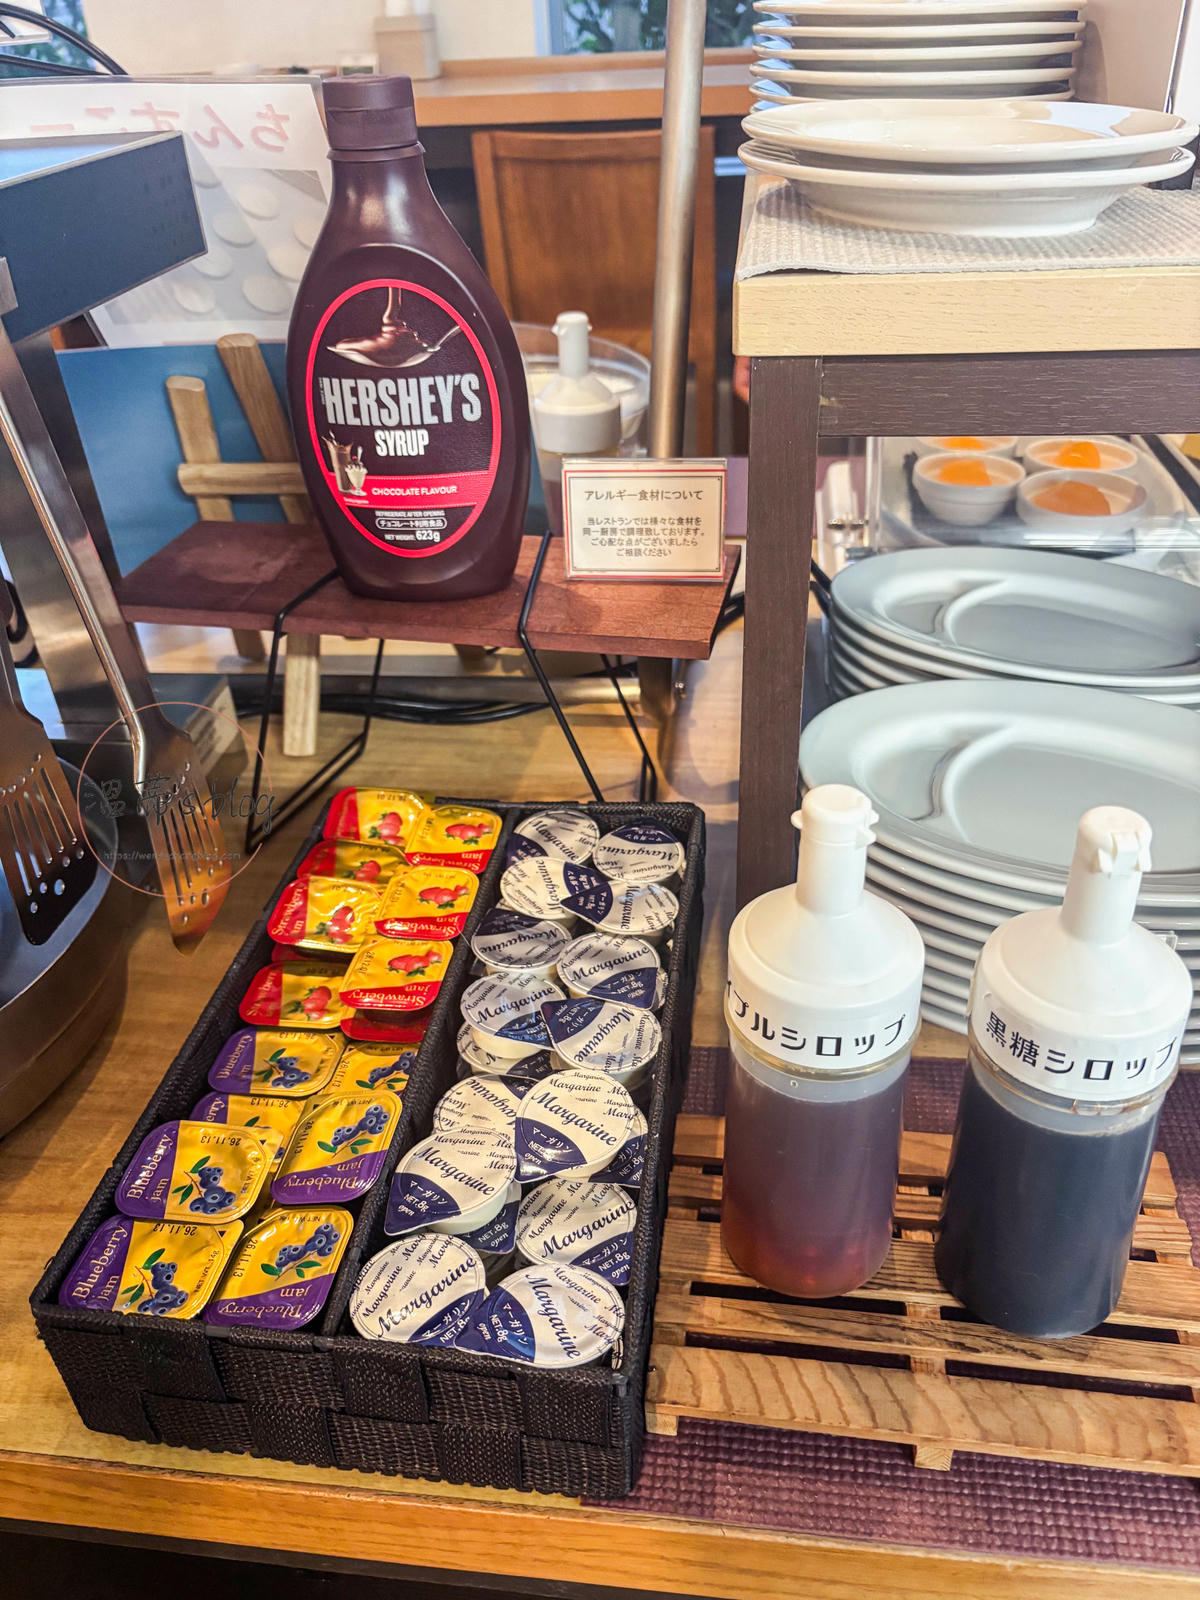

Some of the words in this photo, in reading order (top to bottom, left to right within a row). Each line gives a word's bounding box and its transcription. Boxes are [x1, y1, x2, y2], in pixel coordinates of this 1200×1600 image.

[322, 373, 482, 428] HERSHEY'S
[374, 429, 430, 457] SYRUP
[372, 487, 420, 496] CHOCOLATE
[421, 486, 458, 495] FLAVOUR
[584, 489, 704, 501] アレルギー食材について
[587, 517, 702, 526] 当レストランでは様々な食材を
[416, 530, 441, 543] 623g
[591, 537, 698, 547] ご心配な点がございましたら
[616, 547, 672, 557] ご相談ください
[532, 820, 579, 861] Margarine
[462, 852, 484, 863] jam
[599, 846, 679, 861] Margarine
[536, 860, 560, 910] Margarine
[621, 885, 641, 930] Margarine
[480, 928, 559, 953] Margarine
[561, 943, 593, 969] Margarine
[571, 946, 650, 982] Margarine
[348, 989, 426, 1006] Strawberry
[405, 984, 431, 996] jam
[465, 983, 497, 1010] Margarine
[477, 987, 555, 1023] Margarine
[574, 1008, 635, 1062] Margarine
[985, 1011, 1178, 1081] 黒糖シロップ
[550, 1078, 601, 1092] Margarine
[250, 1097, 290, 1108] 26.11.13
[531, 1091, 617, 1146] Margarine
[200, 1135, 242, 1146] 26.11.13
[434, 1135, 486, 1145] Margarine
[533, 1127, 573, 1153] マーガリン
[127, 1134, 174, 1200] Blueberry
[337, 1158, 364, 1173] jam
[413, 1146, 495, 1196] Margarine
[524, 1153, 541, 1165] open
[145, 1178, 169, 1202] jam
[284, 1175, 359, 1190] Blueberry
[409, 1180, 447, 1205] マーガリン
[398, 1204, 415, 1217] open
[403, 1194, 429, 1213] NET.8g
[153, 1223, 198, 1237] 26.11.13
[528, 1198, 567, 1240] Margarine
[541, 1201, 635, 1259] Margarine
[478, 1222, 509, 1243] NET.8g
[490, 1232, 509, 1248] open
[72, 1225, 128, 1300] Blueberry
[232, 1238, 259, 1278] 26.11.13
[582, 1237, 628, 1266] マーガリン
[598, 1251, 631, 1272] NET.8g
[365, 1261, 389, 1295] Margarine
[611, 1264, 631, 1279] open
[92, 1275, 120, 1301] jam
[280, 1284, 312, 1300] jam
[362, 1265, 403, 1318] Margarine
[377, 1257, 477, 1338] Margarine
[553, 1267, 601, 1304] Margarine
[219, 1302, 303, 1319] Blueberry
[422, 1299, 470, 1338] マーガリン
[525, 1274, 581, 1360] Margarine
[477, 1322, 492, 1341] open
[489, 1314, 509, 1343] NET.8g
[502, 1303, 528, 1345] マーガリン
